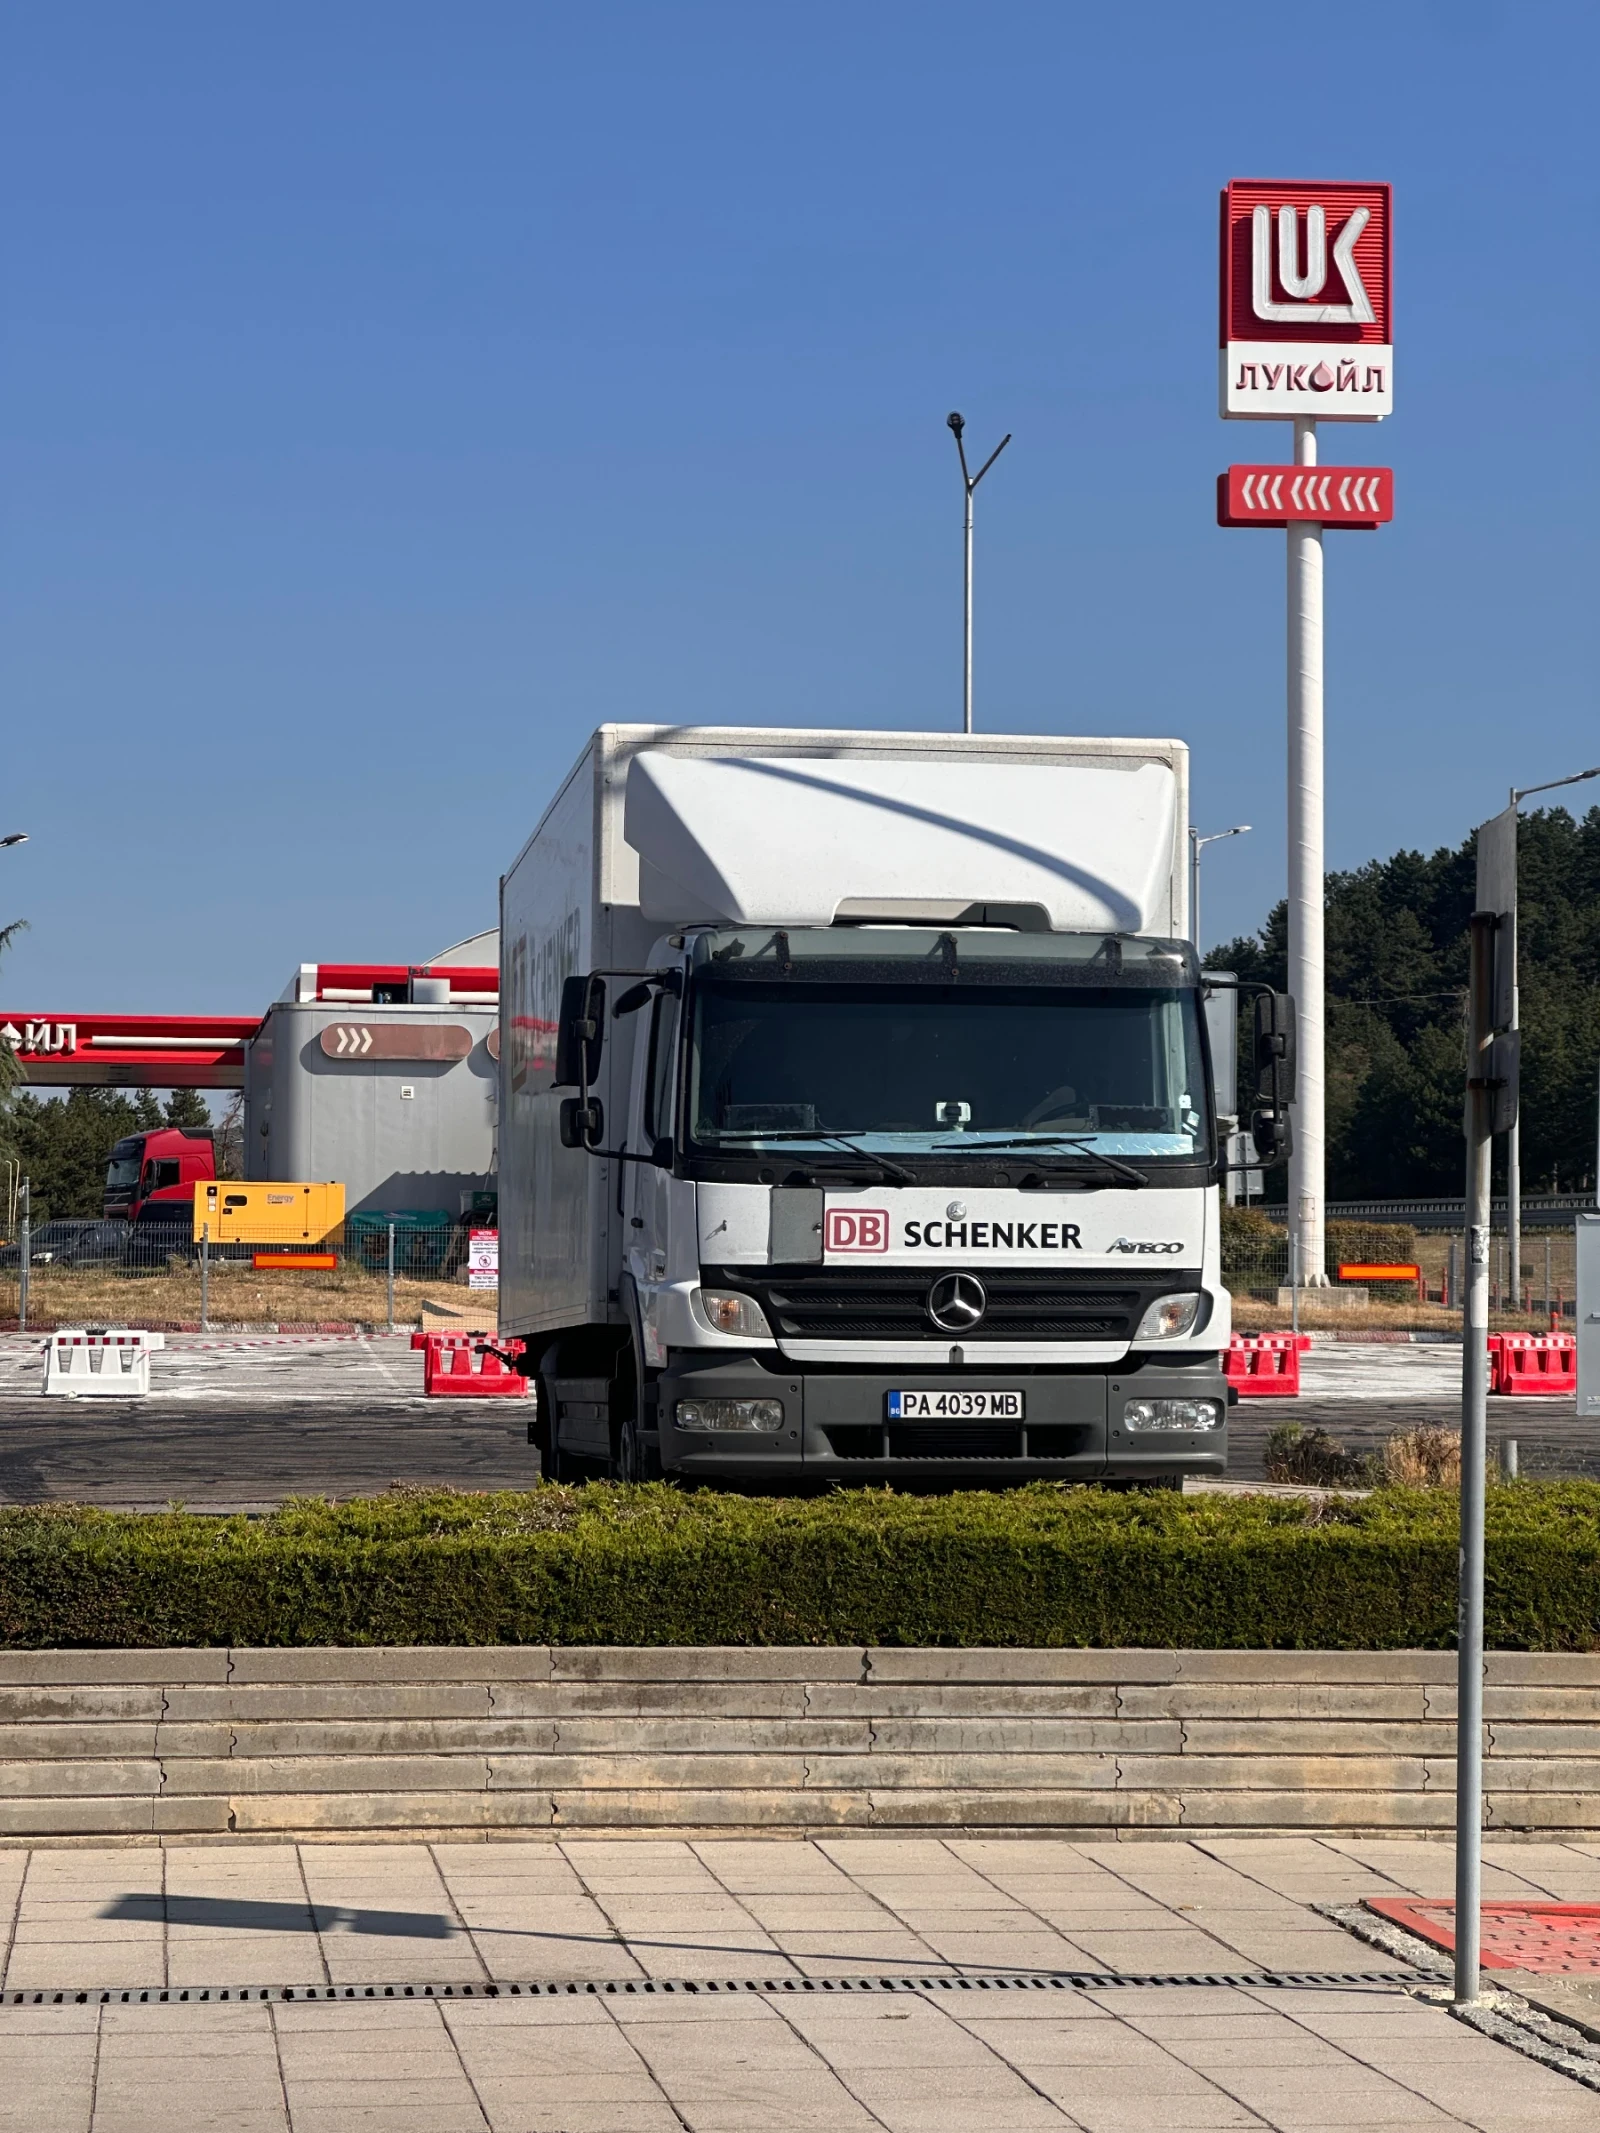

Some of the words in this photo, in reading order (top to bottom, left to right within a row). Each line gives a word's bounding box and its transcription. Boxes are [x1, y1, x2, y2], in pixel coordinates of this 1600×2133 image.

[1235, 357, 1386, 393] ЛУКОЙЛ
[267, 1193, 294, 1203] Energy
[833, 1215, 882, 1246] DB
[903, 1220, 1083, 1249] SCHENKER
[903, 1394, 932, 1416] PA
[935, 1394, 987, 1416] 4039
[990, 1394, 1019, 1416] MB
